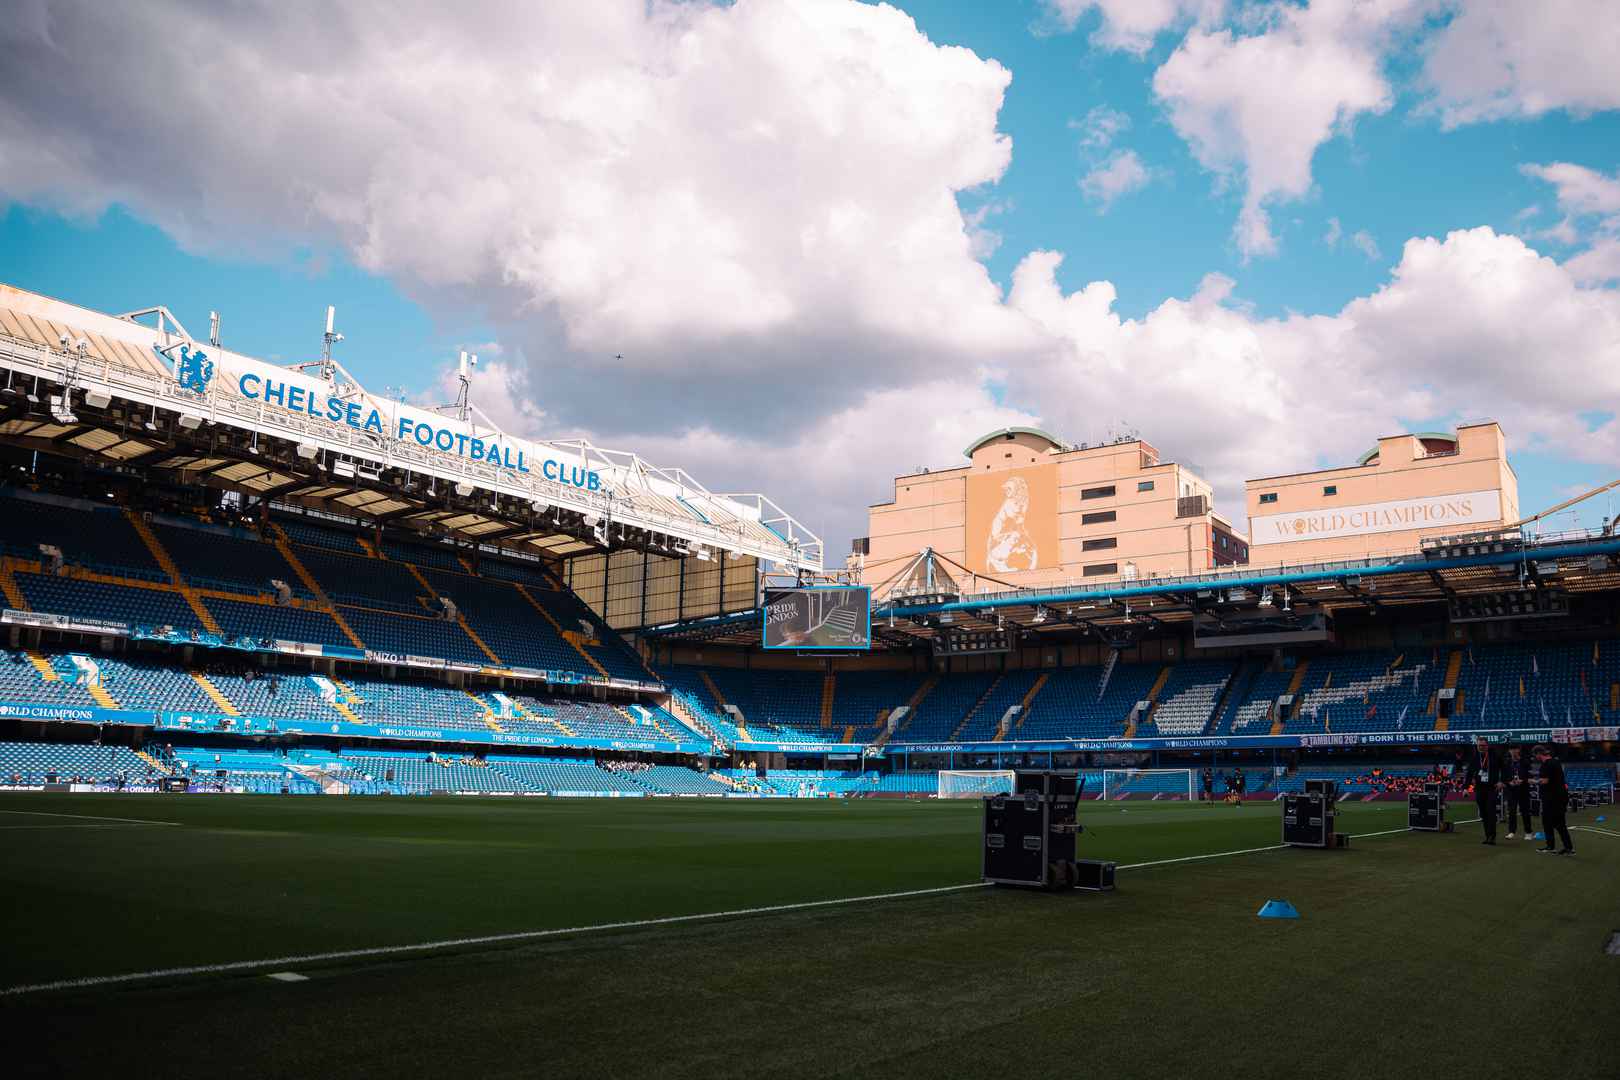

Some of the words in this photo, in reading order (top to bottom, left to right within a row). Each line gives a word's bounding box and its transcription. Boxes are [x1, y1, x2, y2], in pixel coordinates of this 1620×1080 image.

[239, 373, 383, 433] CHELSEA
[399, 417, 530, 473] FOOTBALL
[543, 459, 602, 491] CLUB
[1275, 513, 1345, 535] WORLD
[1350, 500, 1473, 528] CHAMPIONS
[767, 611, 799, 625] ONDON
[31, 707, 93, 720] CHAMPIONS
[380, 728, 404, 736] WORLD
[404, 729, 442, 738] CHAMPIONS
[1369, 735, 1394, 743] BORN
[1396, 734, 1406, 743] IS
[1407, 734, 1425, 742] THE
[1426, 733, 1450, 742] KING
[530, 736, 555, 744] LONDON
[1188, 739, 1229, 748] CHAMPIONS
